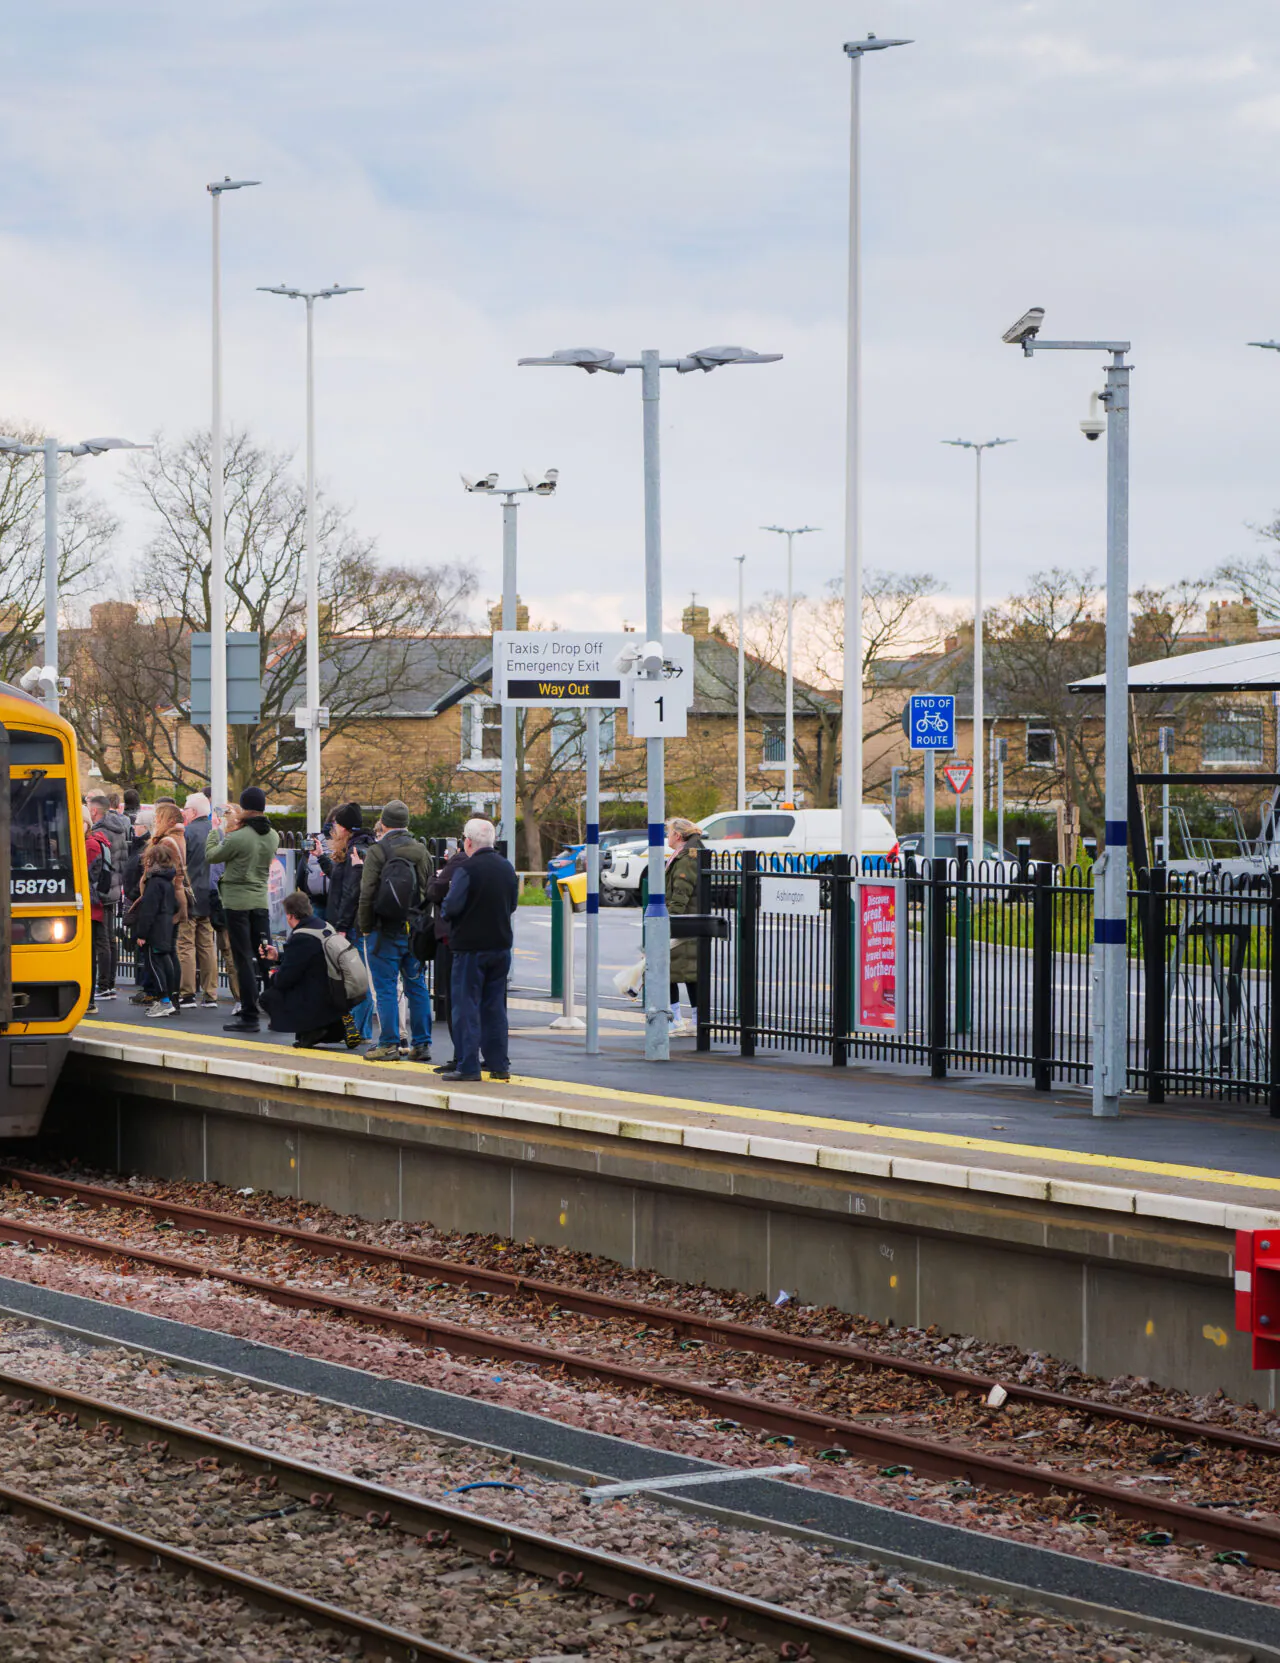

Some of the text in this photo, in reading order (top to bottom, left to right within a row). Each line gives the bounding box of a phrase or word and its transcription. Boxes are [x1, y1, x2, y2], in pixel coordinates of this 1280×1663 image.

[507, 642, 603, 656] Taxis / Drop Off
[506, 660, 600, 674] Emergency Exit
[538, 682, 590, 698] Way Out
[654, 696, 664, 722] 1
[914, 699, 951, 708] END OF
[916, 735, 948, 745] ROUTE
[9, 879, 67, 895] 158791
[776, 889, 805, 904] Ashington
[867, 895, 890, 906] Discover
[863, 906, 882, 926] great
[873, 917, 896, 933] value
[867, 936, 893, 947] when you
[865, 949, 895, 962] travel with
[864, 962, 896, 980] Northern
